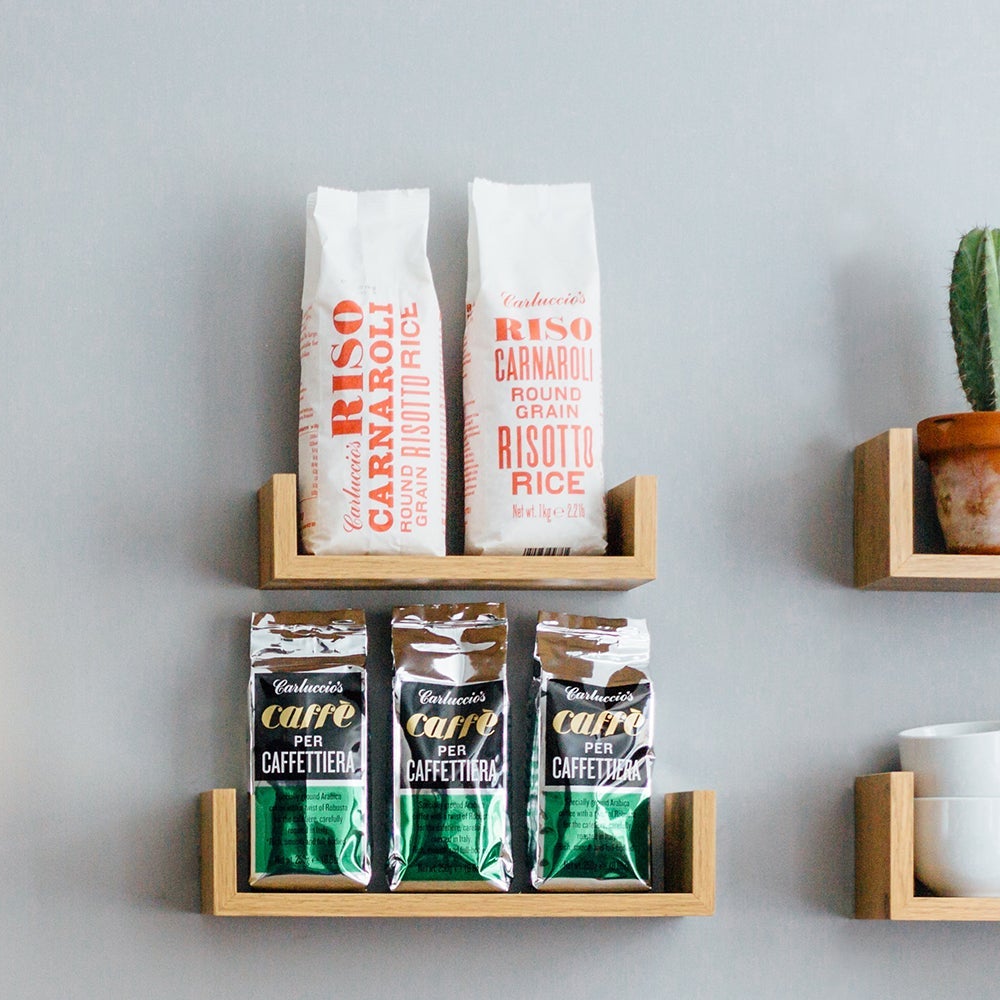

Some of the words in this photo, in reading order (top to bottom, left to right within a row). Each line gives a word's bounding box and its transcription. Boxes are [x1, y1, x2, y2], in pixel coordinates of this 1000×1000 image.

[501, 291, 586, 308] Carluccio's
[400, 302, 421, 369] RICE
[493, 316, 592, 342] RISO
[331, 299, 364, 438] RISO
[494, 346, 593, 382] CARNAROLI
[512, 387, 581, 401] ROUND
[368, 302, 394, 533] CARNAROLI
[401, 375, 430, 458] RISOTTO
[516, 404, 578, 419] GRAIN
[498, 424, 593, 469] RISOTTO
[343, 441, 363, 533] Carluccio's
[511, 471, 585, 495] RICE
[400, 465, 413, 533] ROUND
[416, 467, 428, 527] GRAIN
[512, 504, 524, 518] Net
[273, 678, 343, 695] Carluccio's
[418, 688, 486, 706] Carluccio's
[565, 686, 634, 703] Carluccio's
[261, 700, 356, 730] caffè
[406, 709, 499, 740] caffè
[552, 708, 646, 736] caffè
[294, 735, 323, 747] PER
[438, 744, 467, 756] PER
[584, 742, 613, 754] PER
[262, 750, 356, 774] CAFFETTIERA
[407, 759, 498, 782] CAFFETTIERA
[552, 757, 641, 781] CAFFETTIERA
